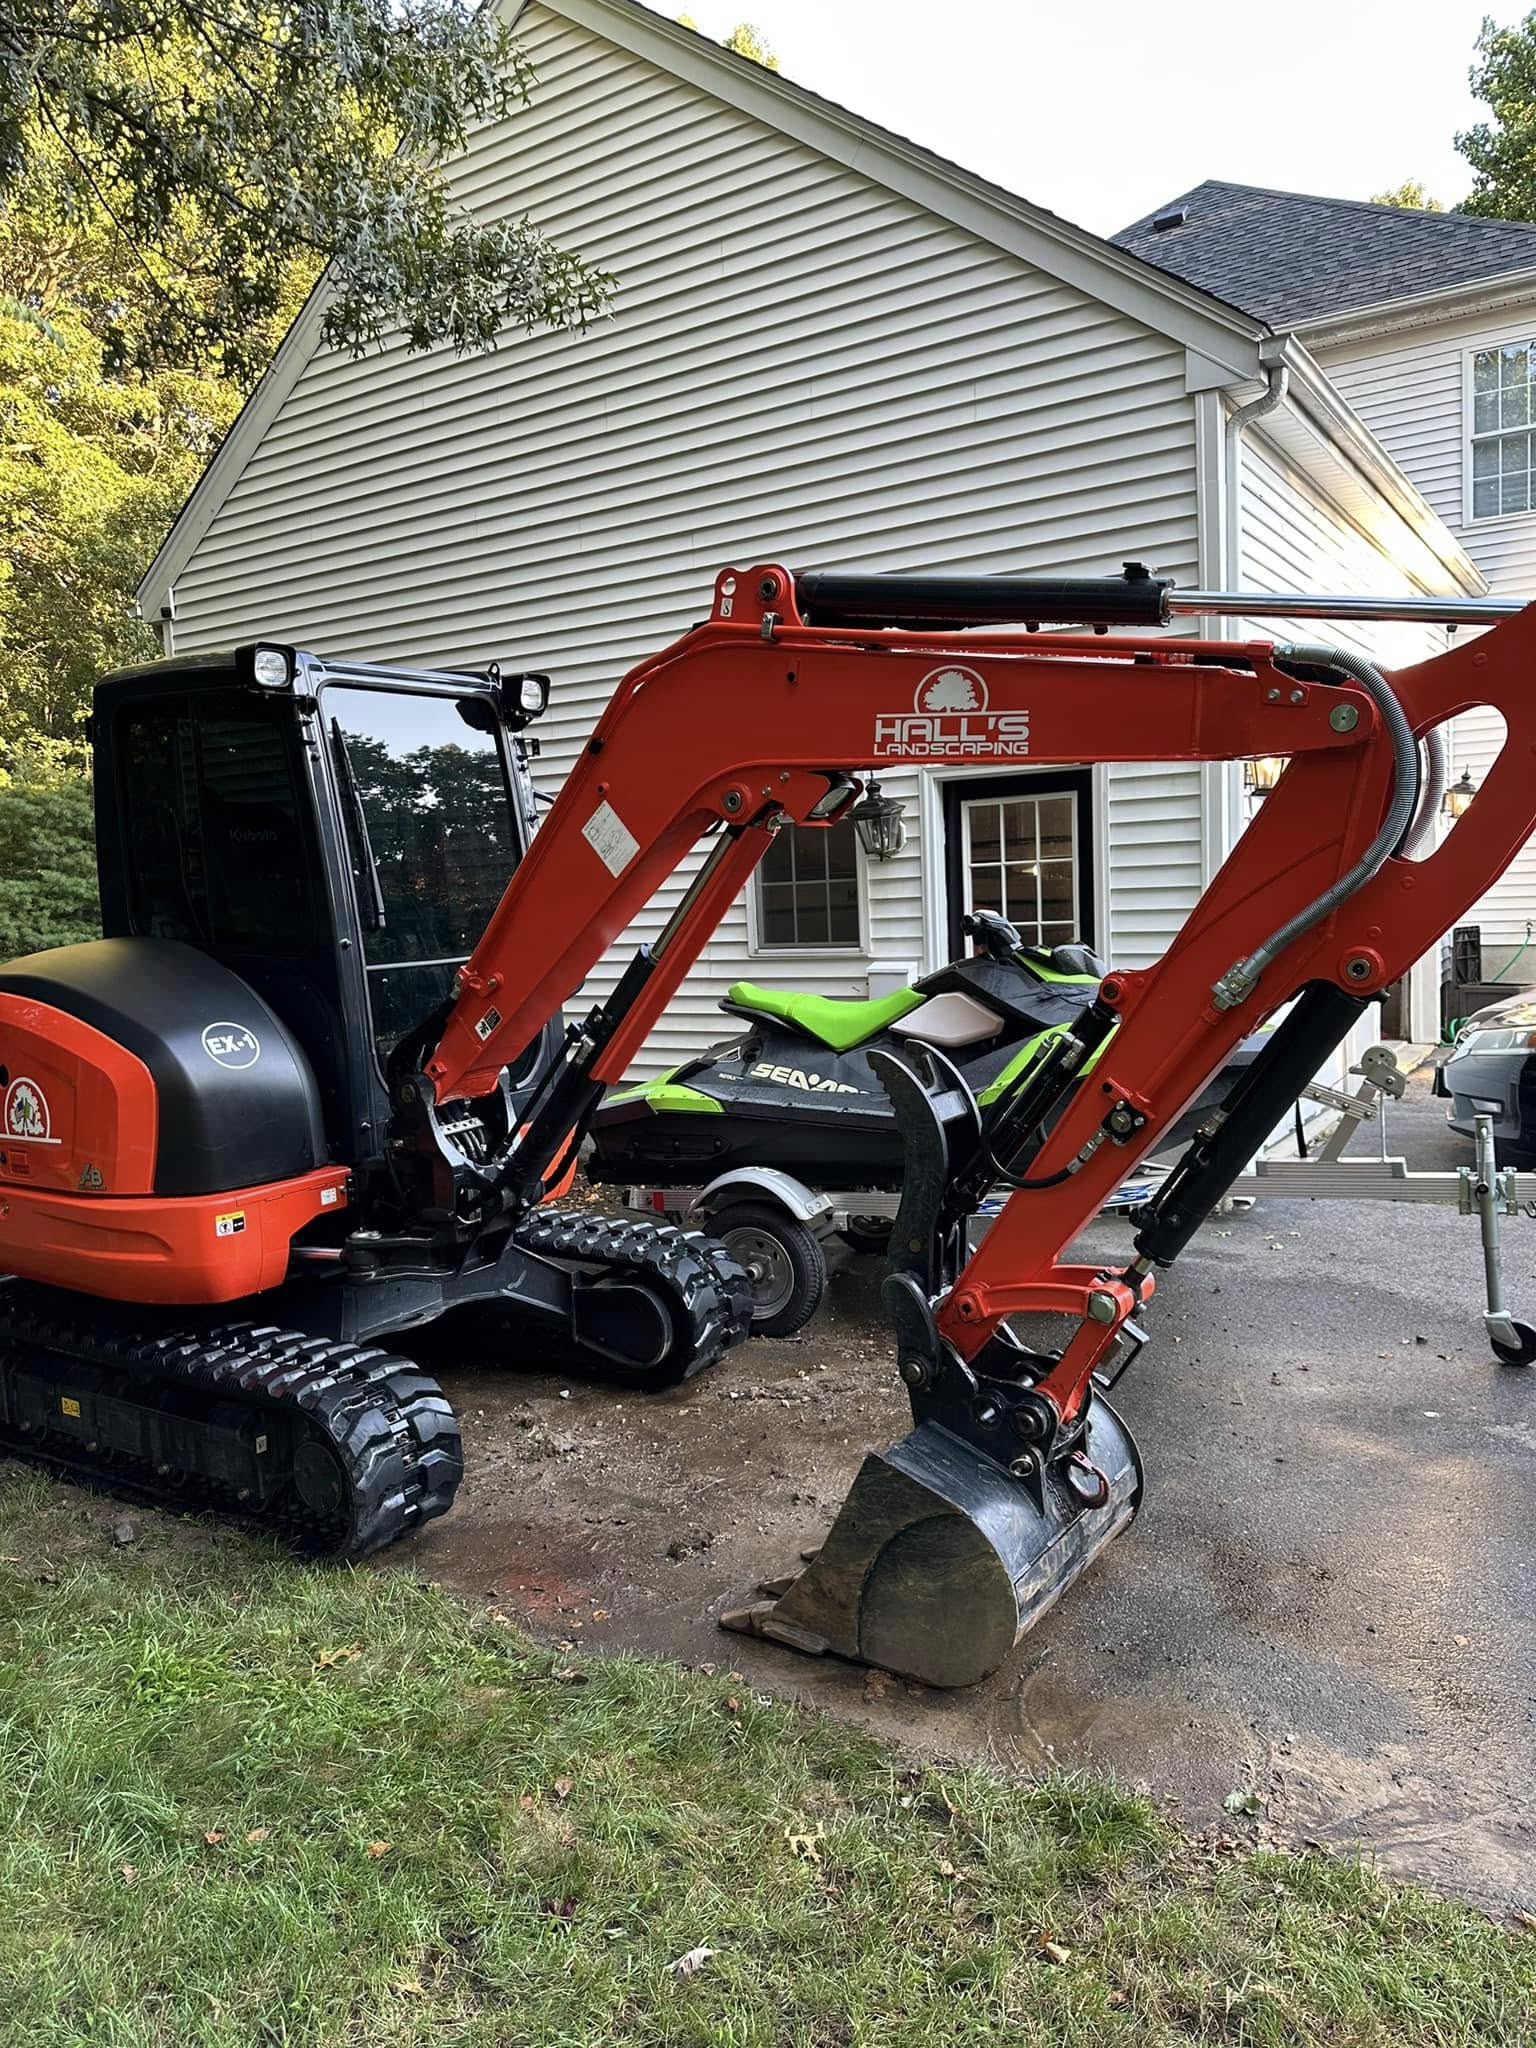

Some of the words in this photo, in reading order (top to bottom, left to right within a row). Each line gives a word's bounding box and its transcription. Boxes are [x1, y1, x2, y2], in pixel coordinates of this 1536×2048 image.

[875, 716, 1029, 743] HALL'S
[873, 742, 1029, 756] LANDSCAPING
[206, 1033, 256, 1055] EX-1
